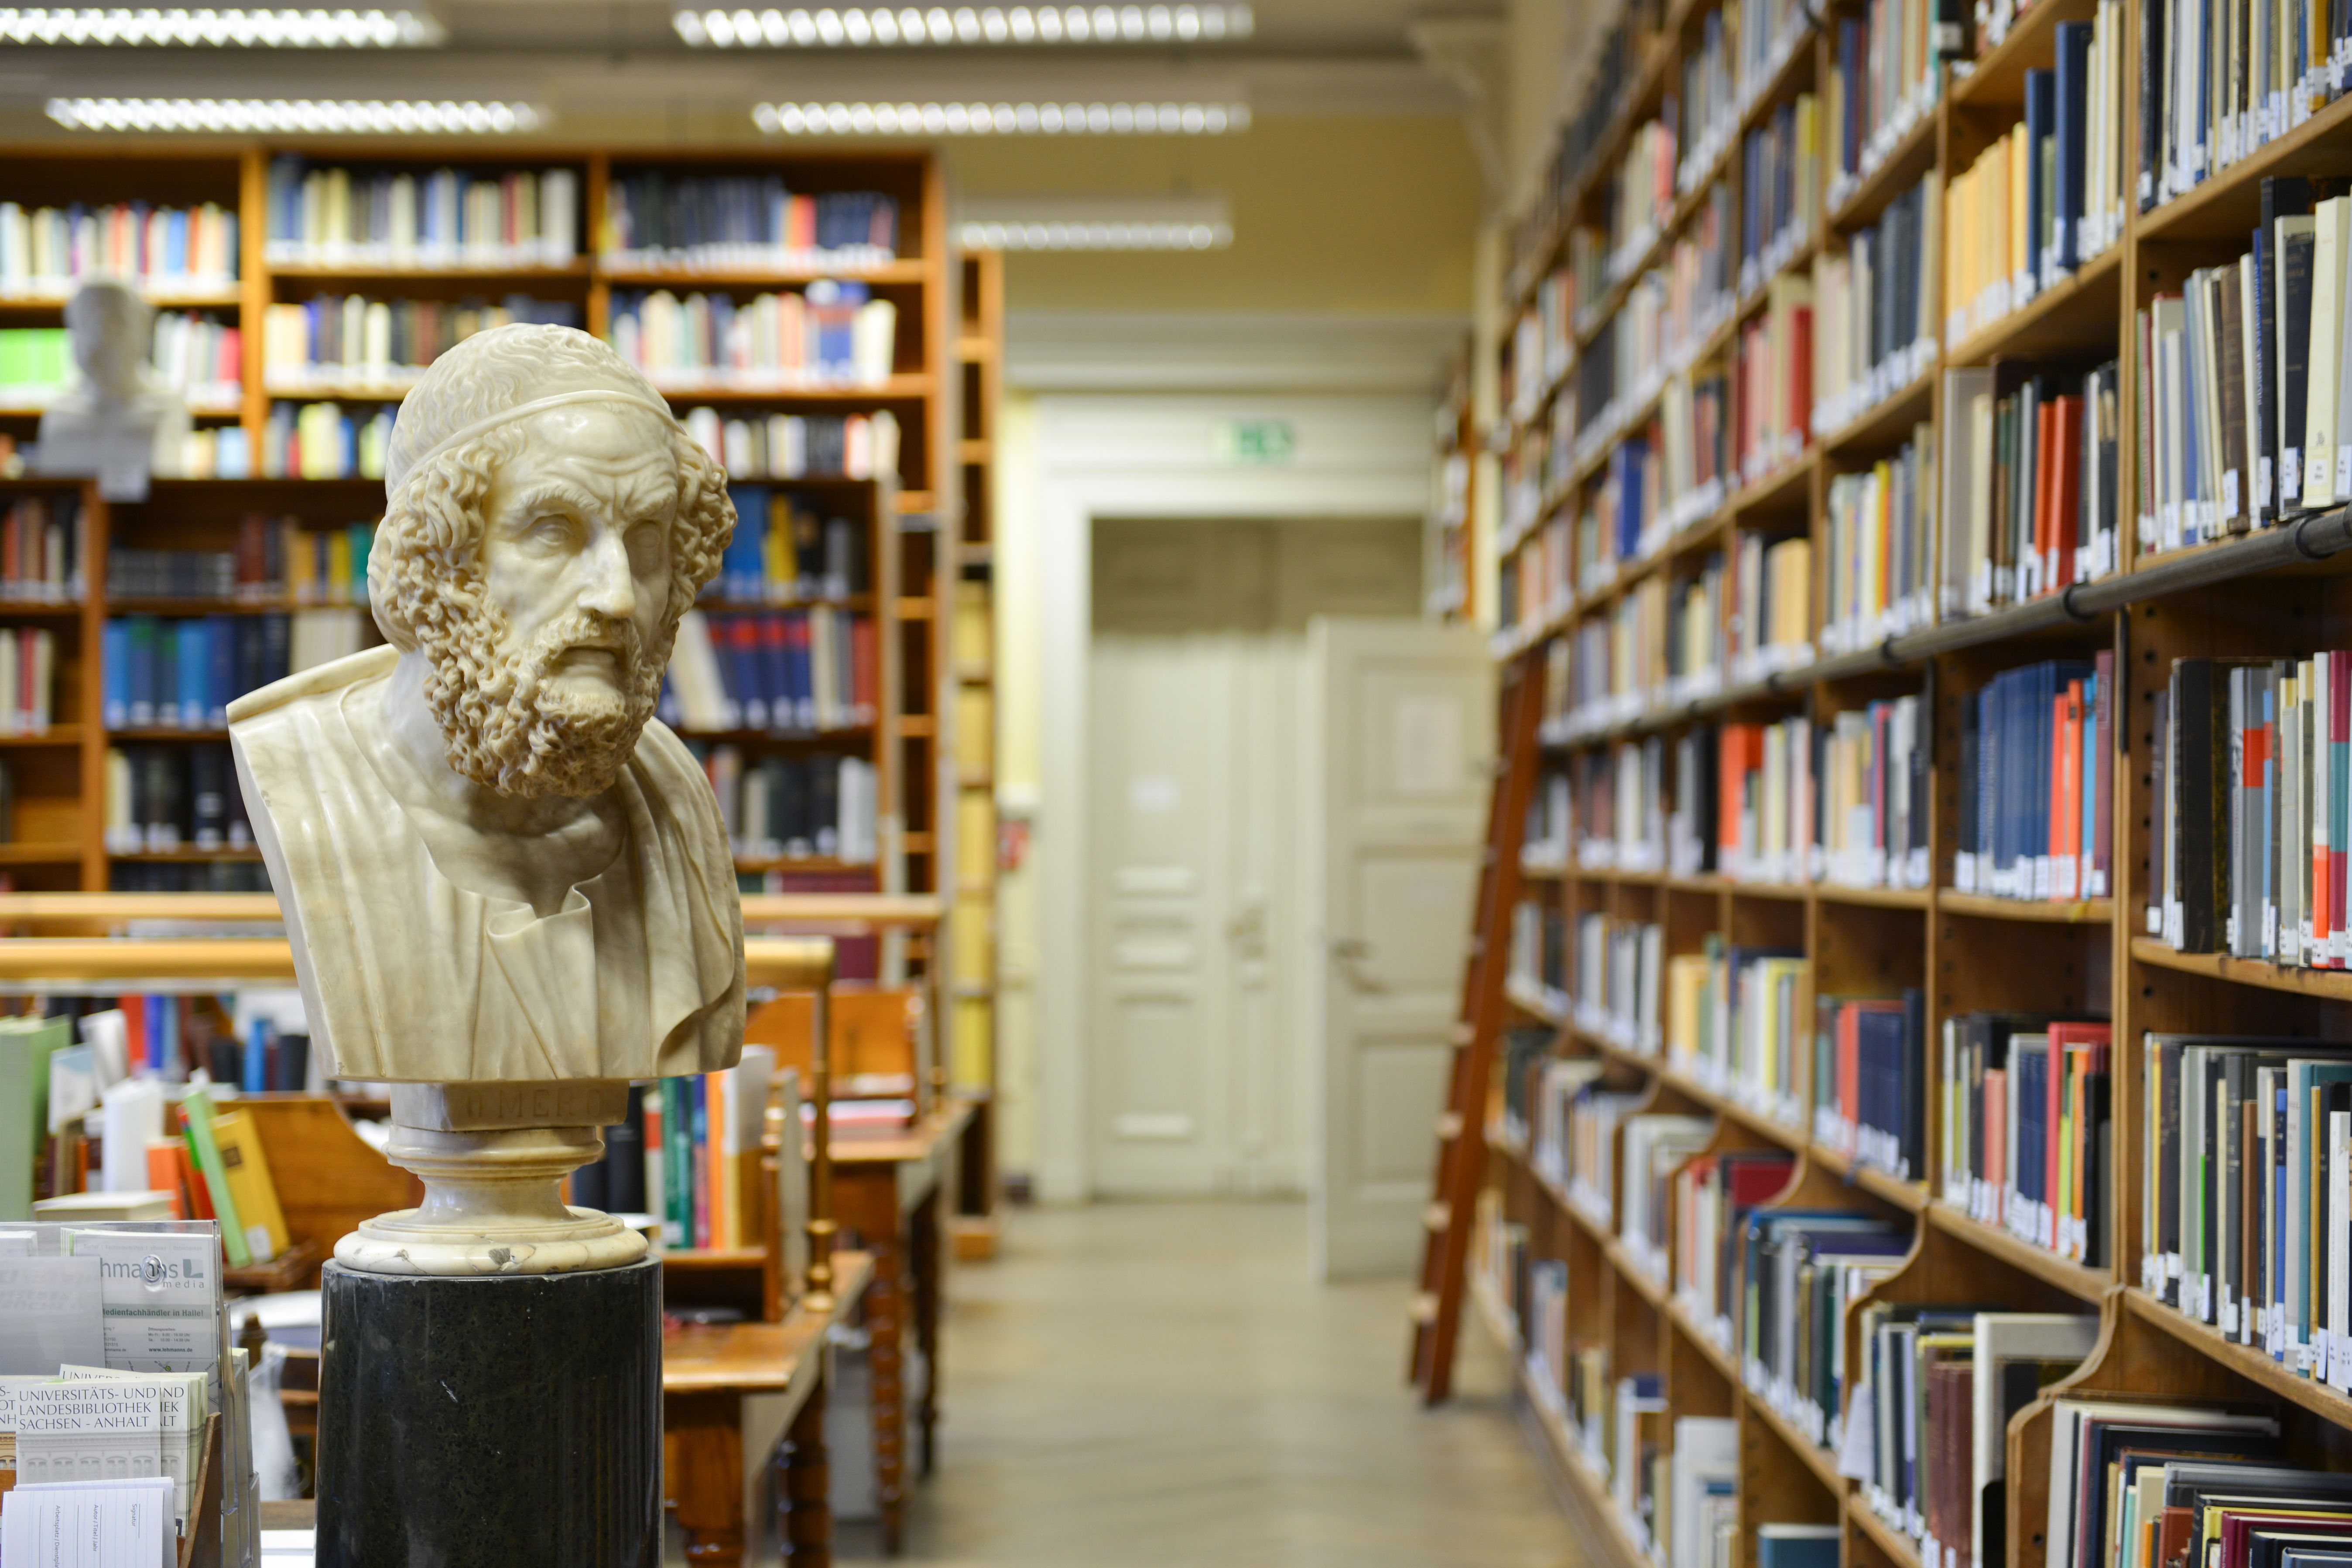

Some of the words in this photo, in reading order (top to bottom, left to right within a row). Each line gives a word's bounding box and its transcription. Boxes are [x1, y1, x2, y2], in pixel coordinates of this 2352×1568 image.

[163, 1280, 204, 1288] media
[19, 1387, 119, 1401] UNIVERSITÄTS-
[124, 1387, 156, 1399] UND
[160, 1387, 184, 1398] ND
[20, 1402, 151, 1416] LANDESBIBLIOTHEK
[160, 1401, 179, 1412] EK
[19, 1418, 81, 1430] SACHSEN
[94, 1416, 149, 1428] ANHALT
